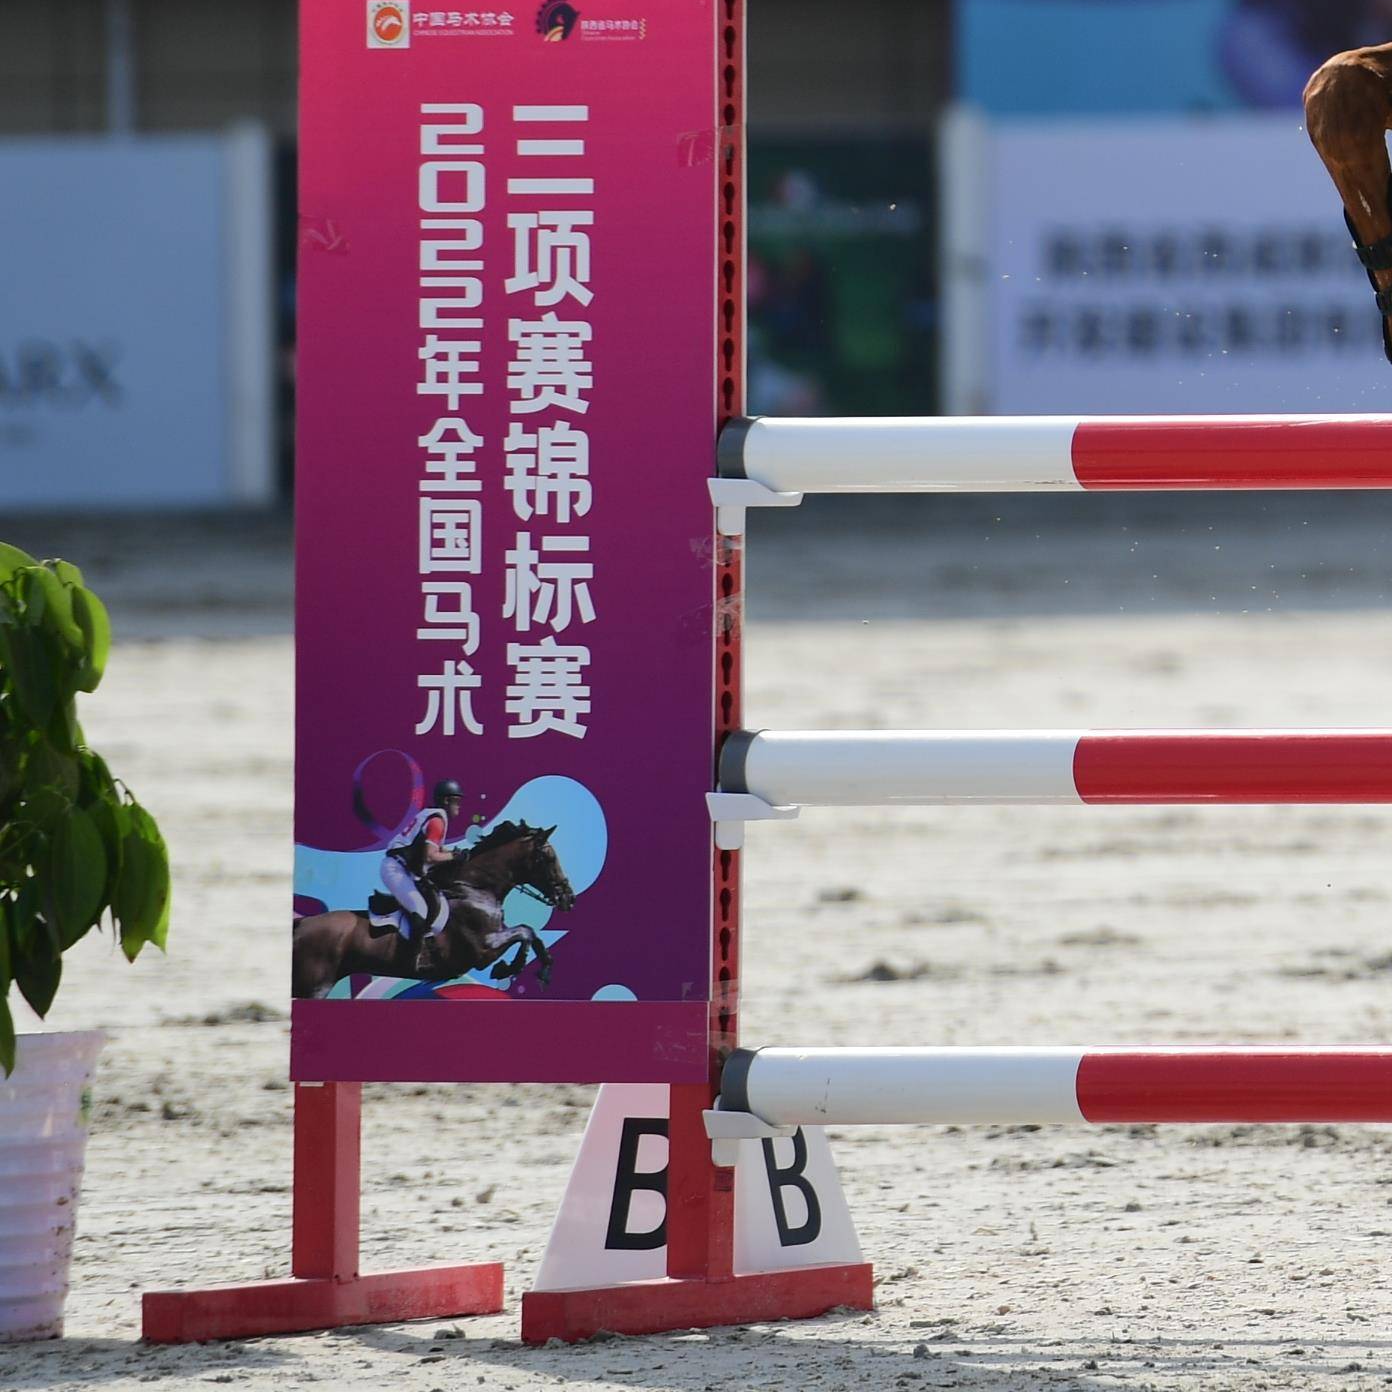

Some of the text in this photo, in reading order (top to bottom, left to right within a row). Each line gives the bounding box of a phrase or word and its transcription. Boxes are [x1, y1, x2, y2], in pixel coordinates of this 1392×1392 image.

[415, 103, 486, 736] 2022年全国马术
[502, 105, 596, 740] 三项赛锦标赛
[604, 1116, 669, 1250] B
[761, 1125, 822, 1247] B
